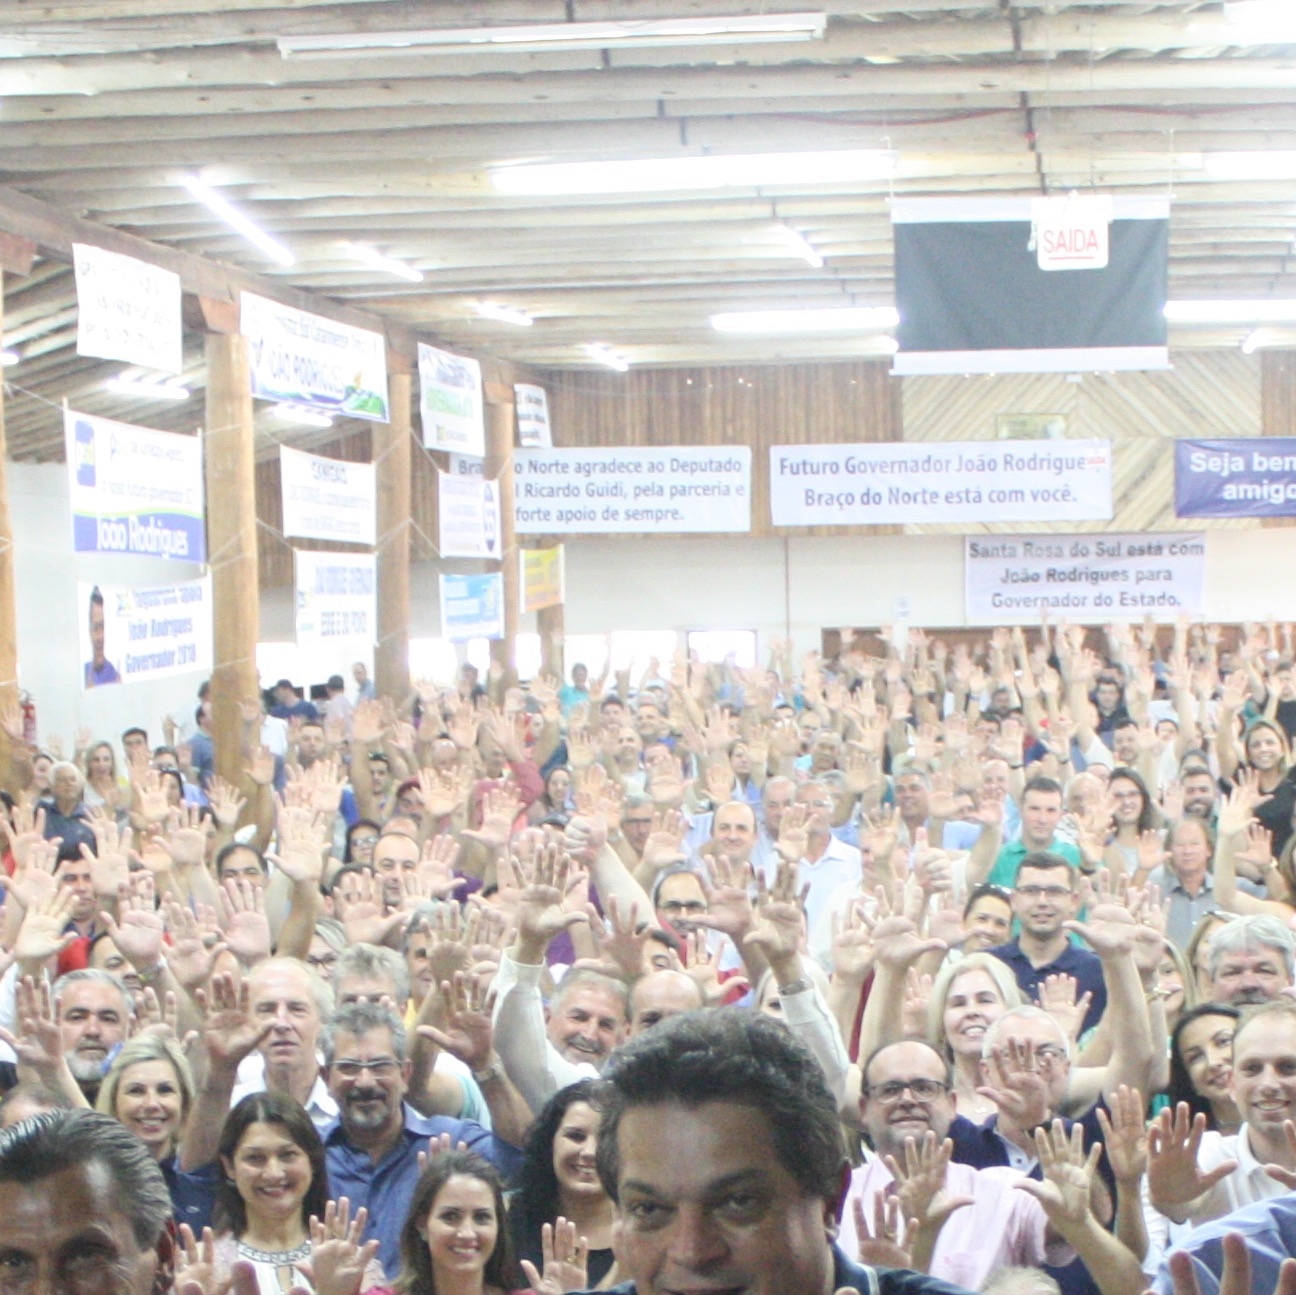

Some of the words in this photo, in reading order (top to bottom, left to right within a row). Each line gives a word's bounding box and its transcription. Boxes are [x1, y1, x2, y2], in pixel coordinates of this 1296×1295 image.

[527, 458, 570, 475] Norte
[573, 457, 644, 478] agradece
[646, 461, 665, 474] ao
[669, 457, 743, 477] Deputado
[778, 457, 841, 477] Futuro
[844, 454, 952, 476] Governador
[955, 453, 999, 474] João
[1003, 451, 1087, 477] Rodrigue
[1189, 451, 1245, 478] Seja
[524, 482, 581, 498] Ricardo
[584, 482, 628, 501] Guidi,
[632, 482, 665, 500] pela
[668, 480, 731, 500] parceria
[734, 485, 746, 497] e
[804, 487, 855, 513] Braço
[859, 486, 883, 507] do
[887, 485, 940, 506] Norte
[943, 484, 983, 506] está
[987, 487, 1025, 504] com
[1028, 482, 1078, 504] você.
[515, 506, 552, 522] forte
[556, 505, 598, 525] apoio
[601, 505, 620, 522] de
[623, 508, 685, 525] sempre.
[96, 512, 128, 550] João
[128, 513, 190, 560] Rodrigues
[969, 541, 1018, 559] Santa
[1022, 541, 1065, 559] Rosa
[1068, 540, 1091, 558] do
[1094, 540, 1122, 558] Sul
[1125, 539, 1164, 557] está
[1167, 541, 1204, 556] com
[999, 567, 1041, 584] João
[1045, 566, 1130, 587] Rodrigues
[1134, 568, 1173, 586] para
[990, 591, 1089, 609] Governador
[1092, 590, 1114, 608] do
[1119, 590, 1182, 608] Estado.
